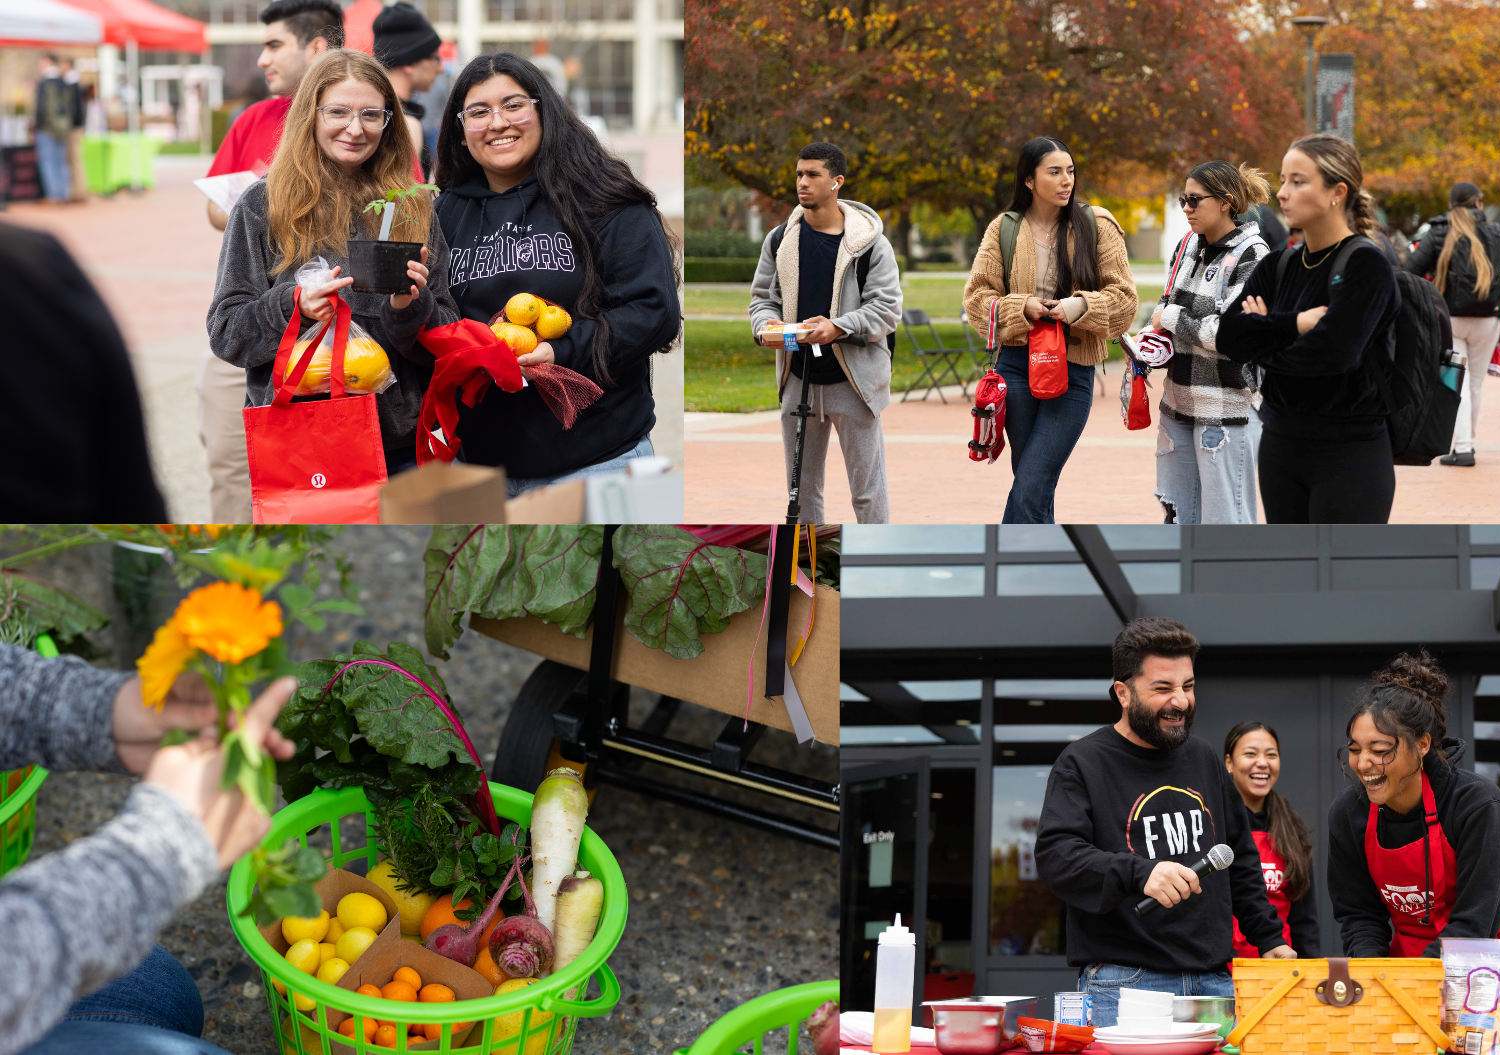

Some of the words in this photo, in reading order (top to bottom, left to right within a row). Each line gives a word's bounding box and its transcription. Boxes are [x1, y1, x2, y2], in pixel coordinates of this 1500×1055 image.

[862, 831, 878, 844] Exit
[877, 830, 895, 844] Only
[1142, 809, 1204, 860] FMP
